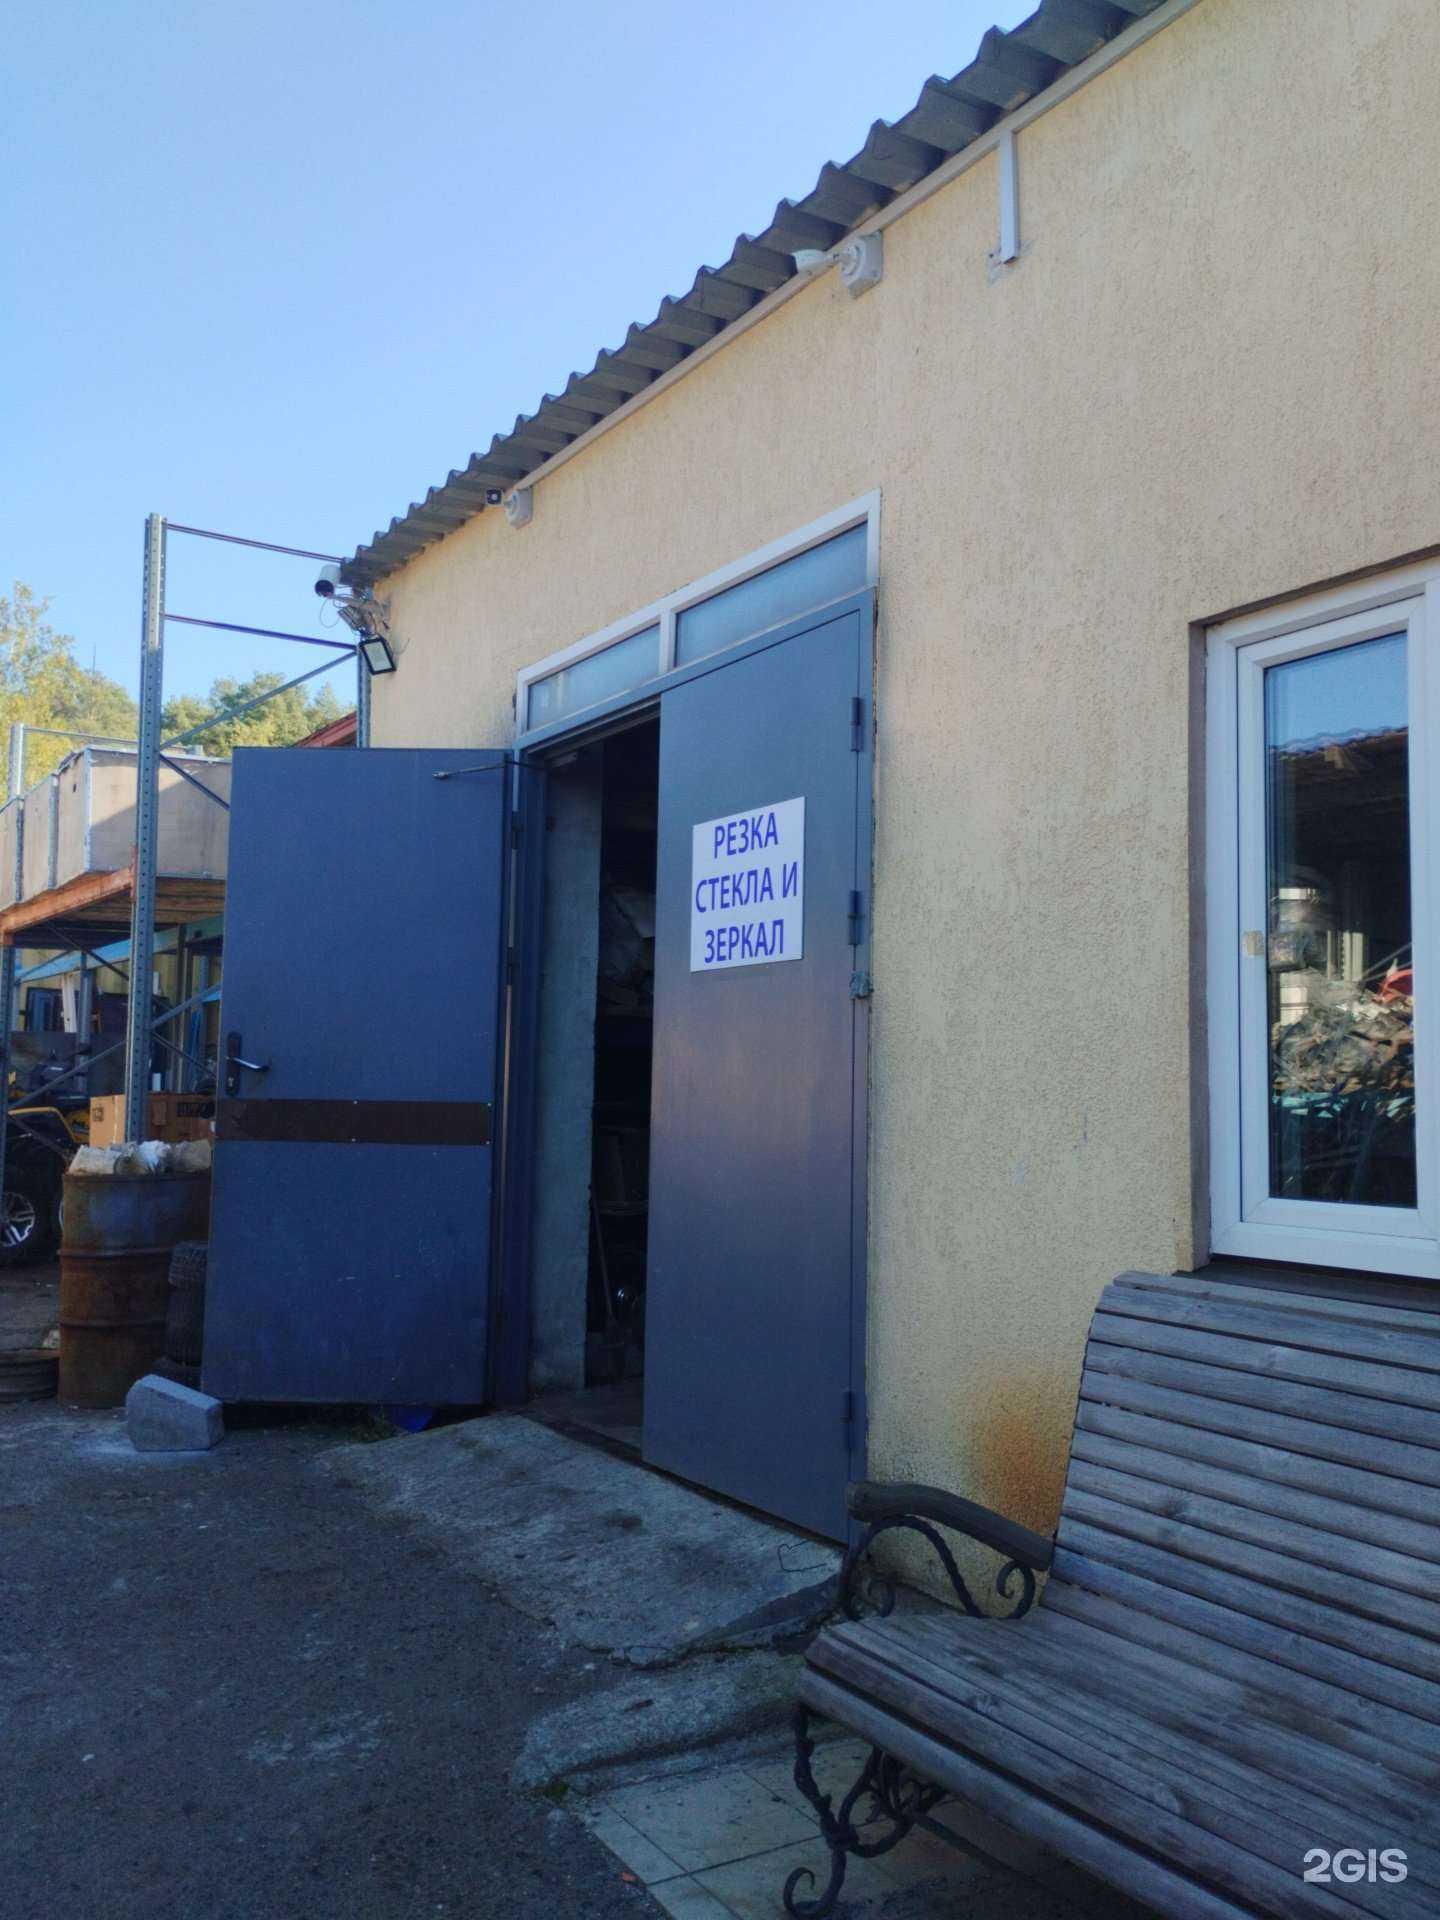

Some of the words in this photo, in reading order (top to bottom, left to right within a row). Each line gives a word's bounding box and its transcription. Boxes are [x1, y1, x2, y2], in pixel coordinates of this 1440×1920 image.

[714, 812, 779, 859] РЕЗКА
[695, 867, 774, 913] СТЕКЛА
[782, 861, 798, 899] И
[704, 919, 784, 963] ЗЕРКАЛ
